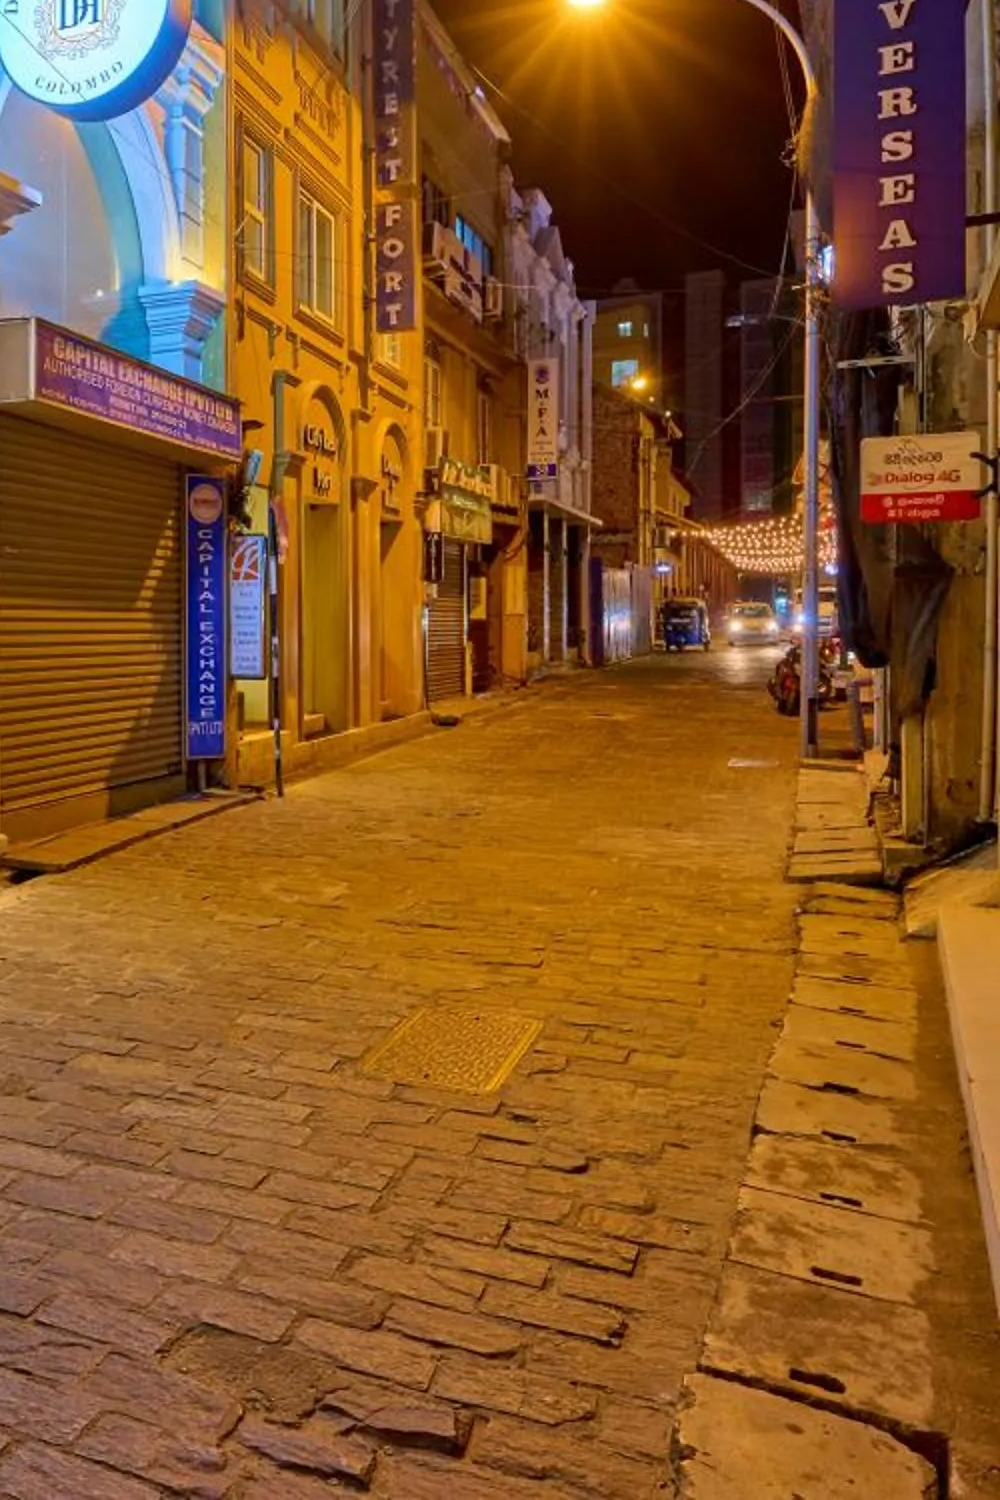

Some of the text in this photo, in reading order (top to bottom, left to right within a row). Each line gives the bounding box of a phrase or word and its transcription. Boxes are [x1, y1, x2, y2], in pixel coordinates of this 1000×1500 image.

[34, 59, 125, 96] COLOMBO
[382, 205, 405, 326] FORT
[52, 337, 116, 379] CAPITAL
[117, 360, 184, 405] EXCHANGE
[884, 471, 935, 485] Dialog
[197, 528, 214, 614] CAPITAL
[199, 620, 216, 719] EXCHANGE
